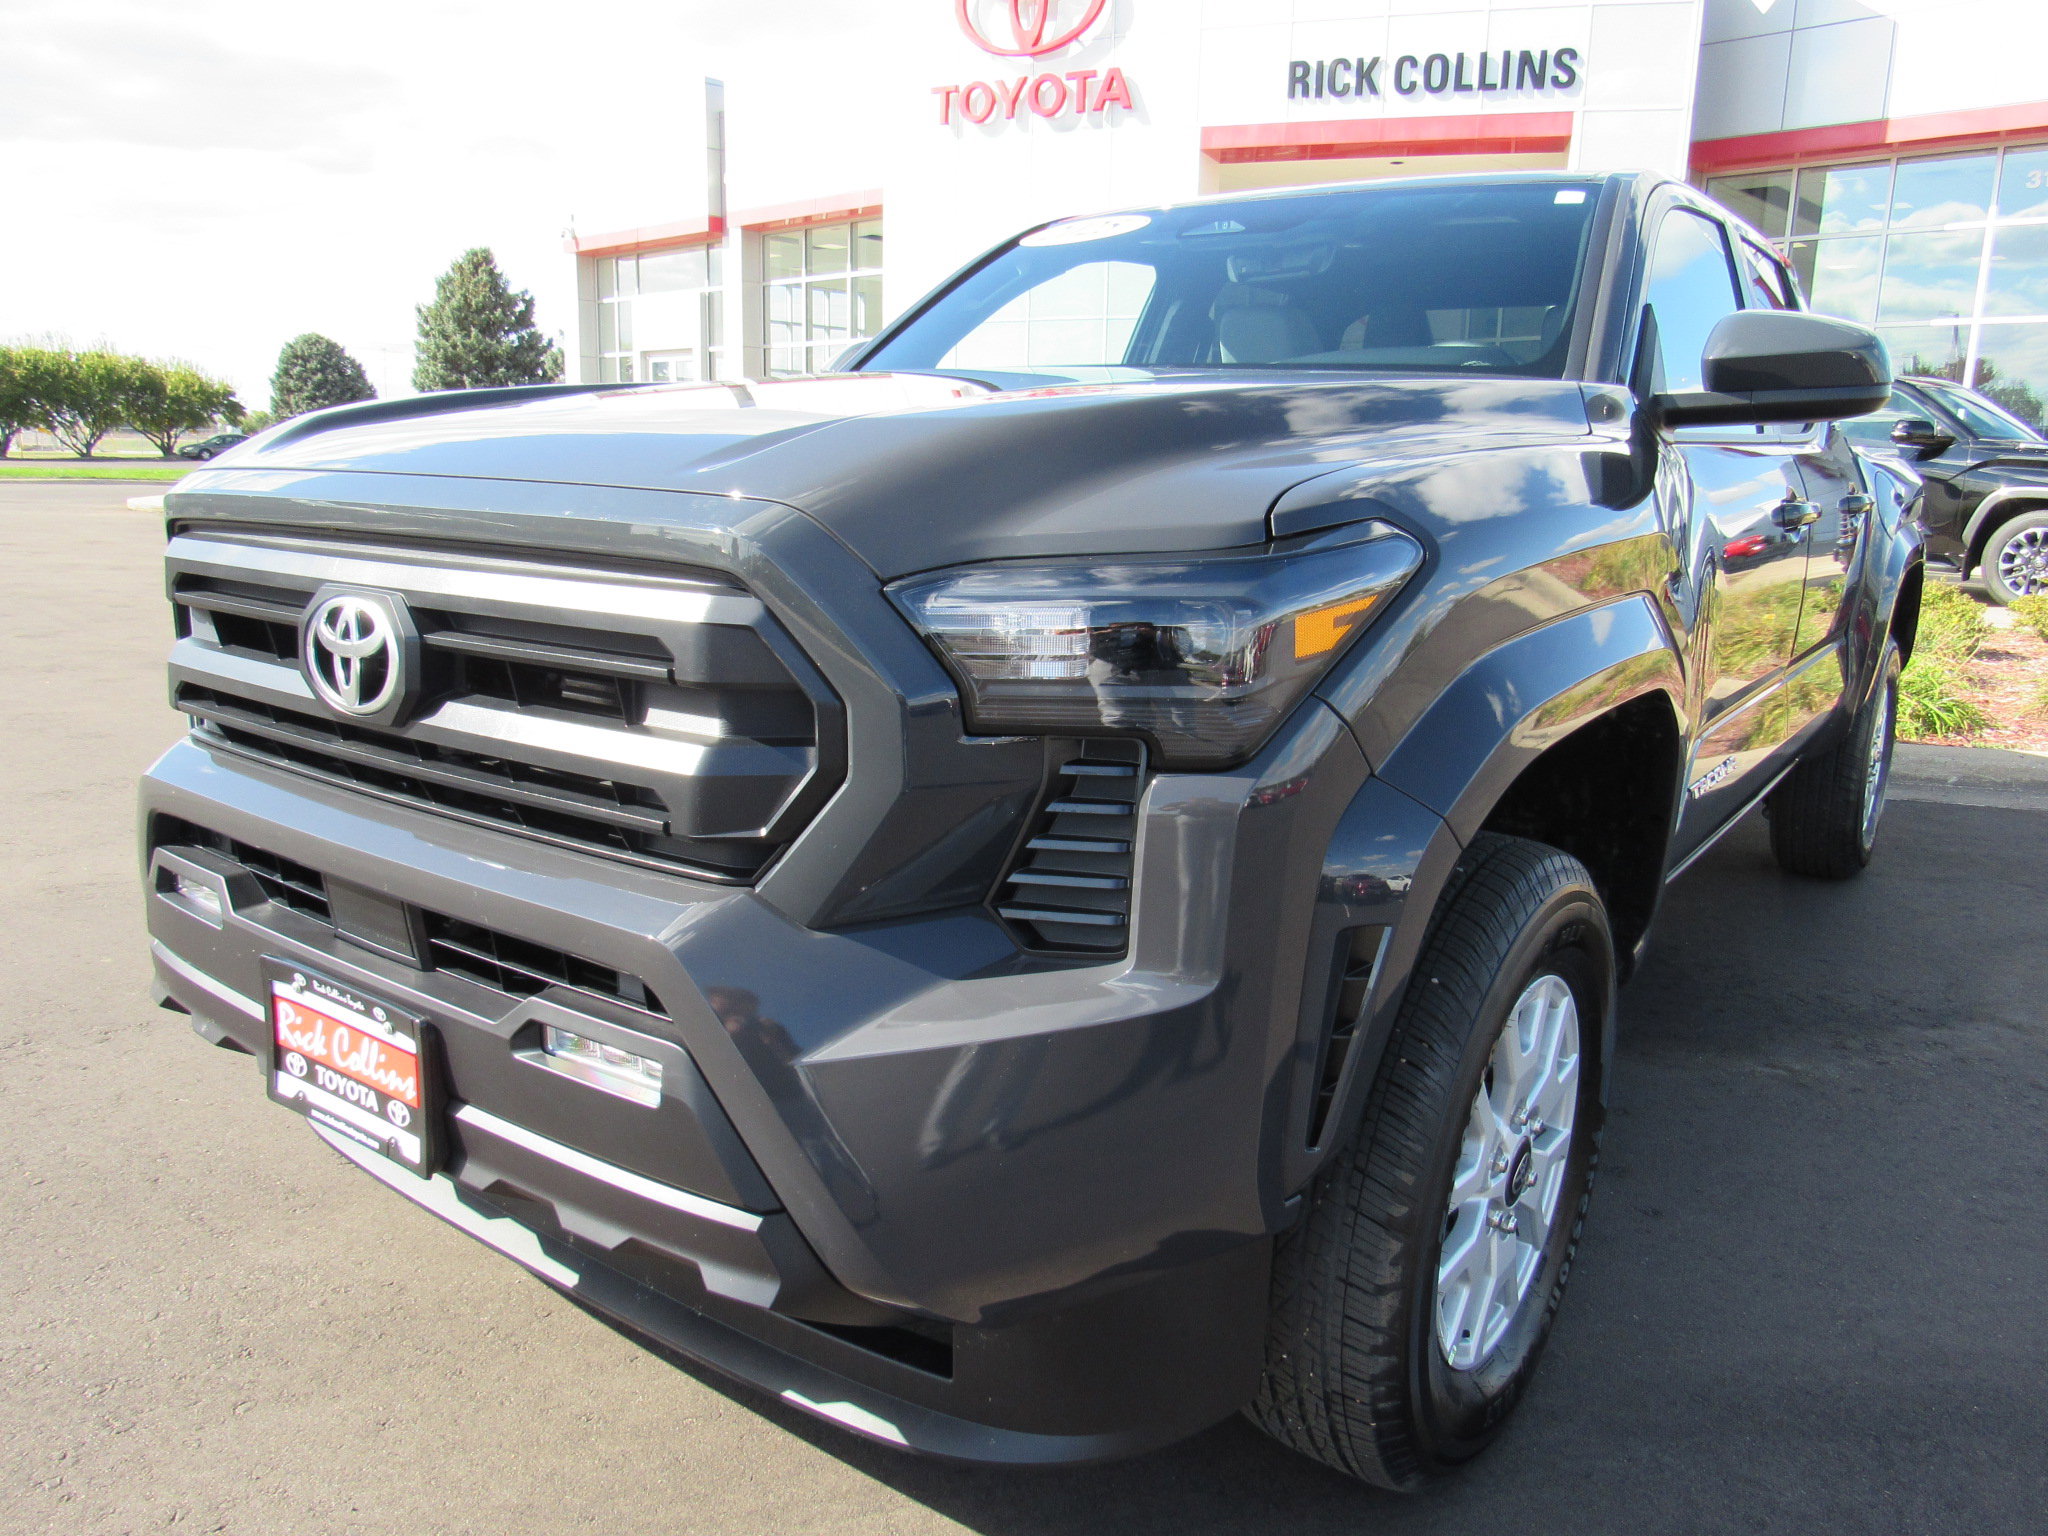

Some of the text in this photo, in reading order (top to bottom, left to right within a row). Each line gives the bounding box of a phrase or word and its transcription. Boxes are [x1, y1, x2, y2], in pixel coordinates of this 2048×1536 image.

[931, 67, 1132, 125] TOYOTA
[1288, 48, 1578, 99] RICK COLLINS
[278, 1001, 417, 1101] Rick Collins
[315, 1064, 380, 1113] TOYOTA
